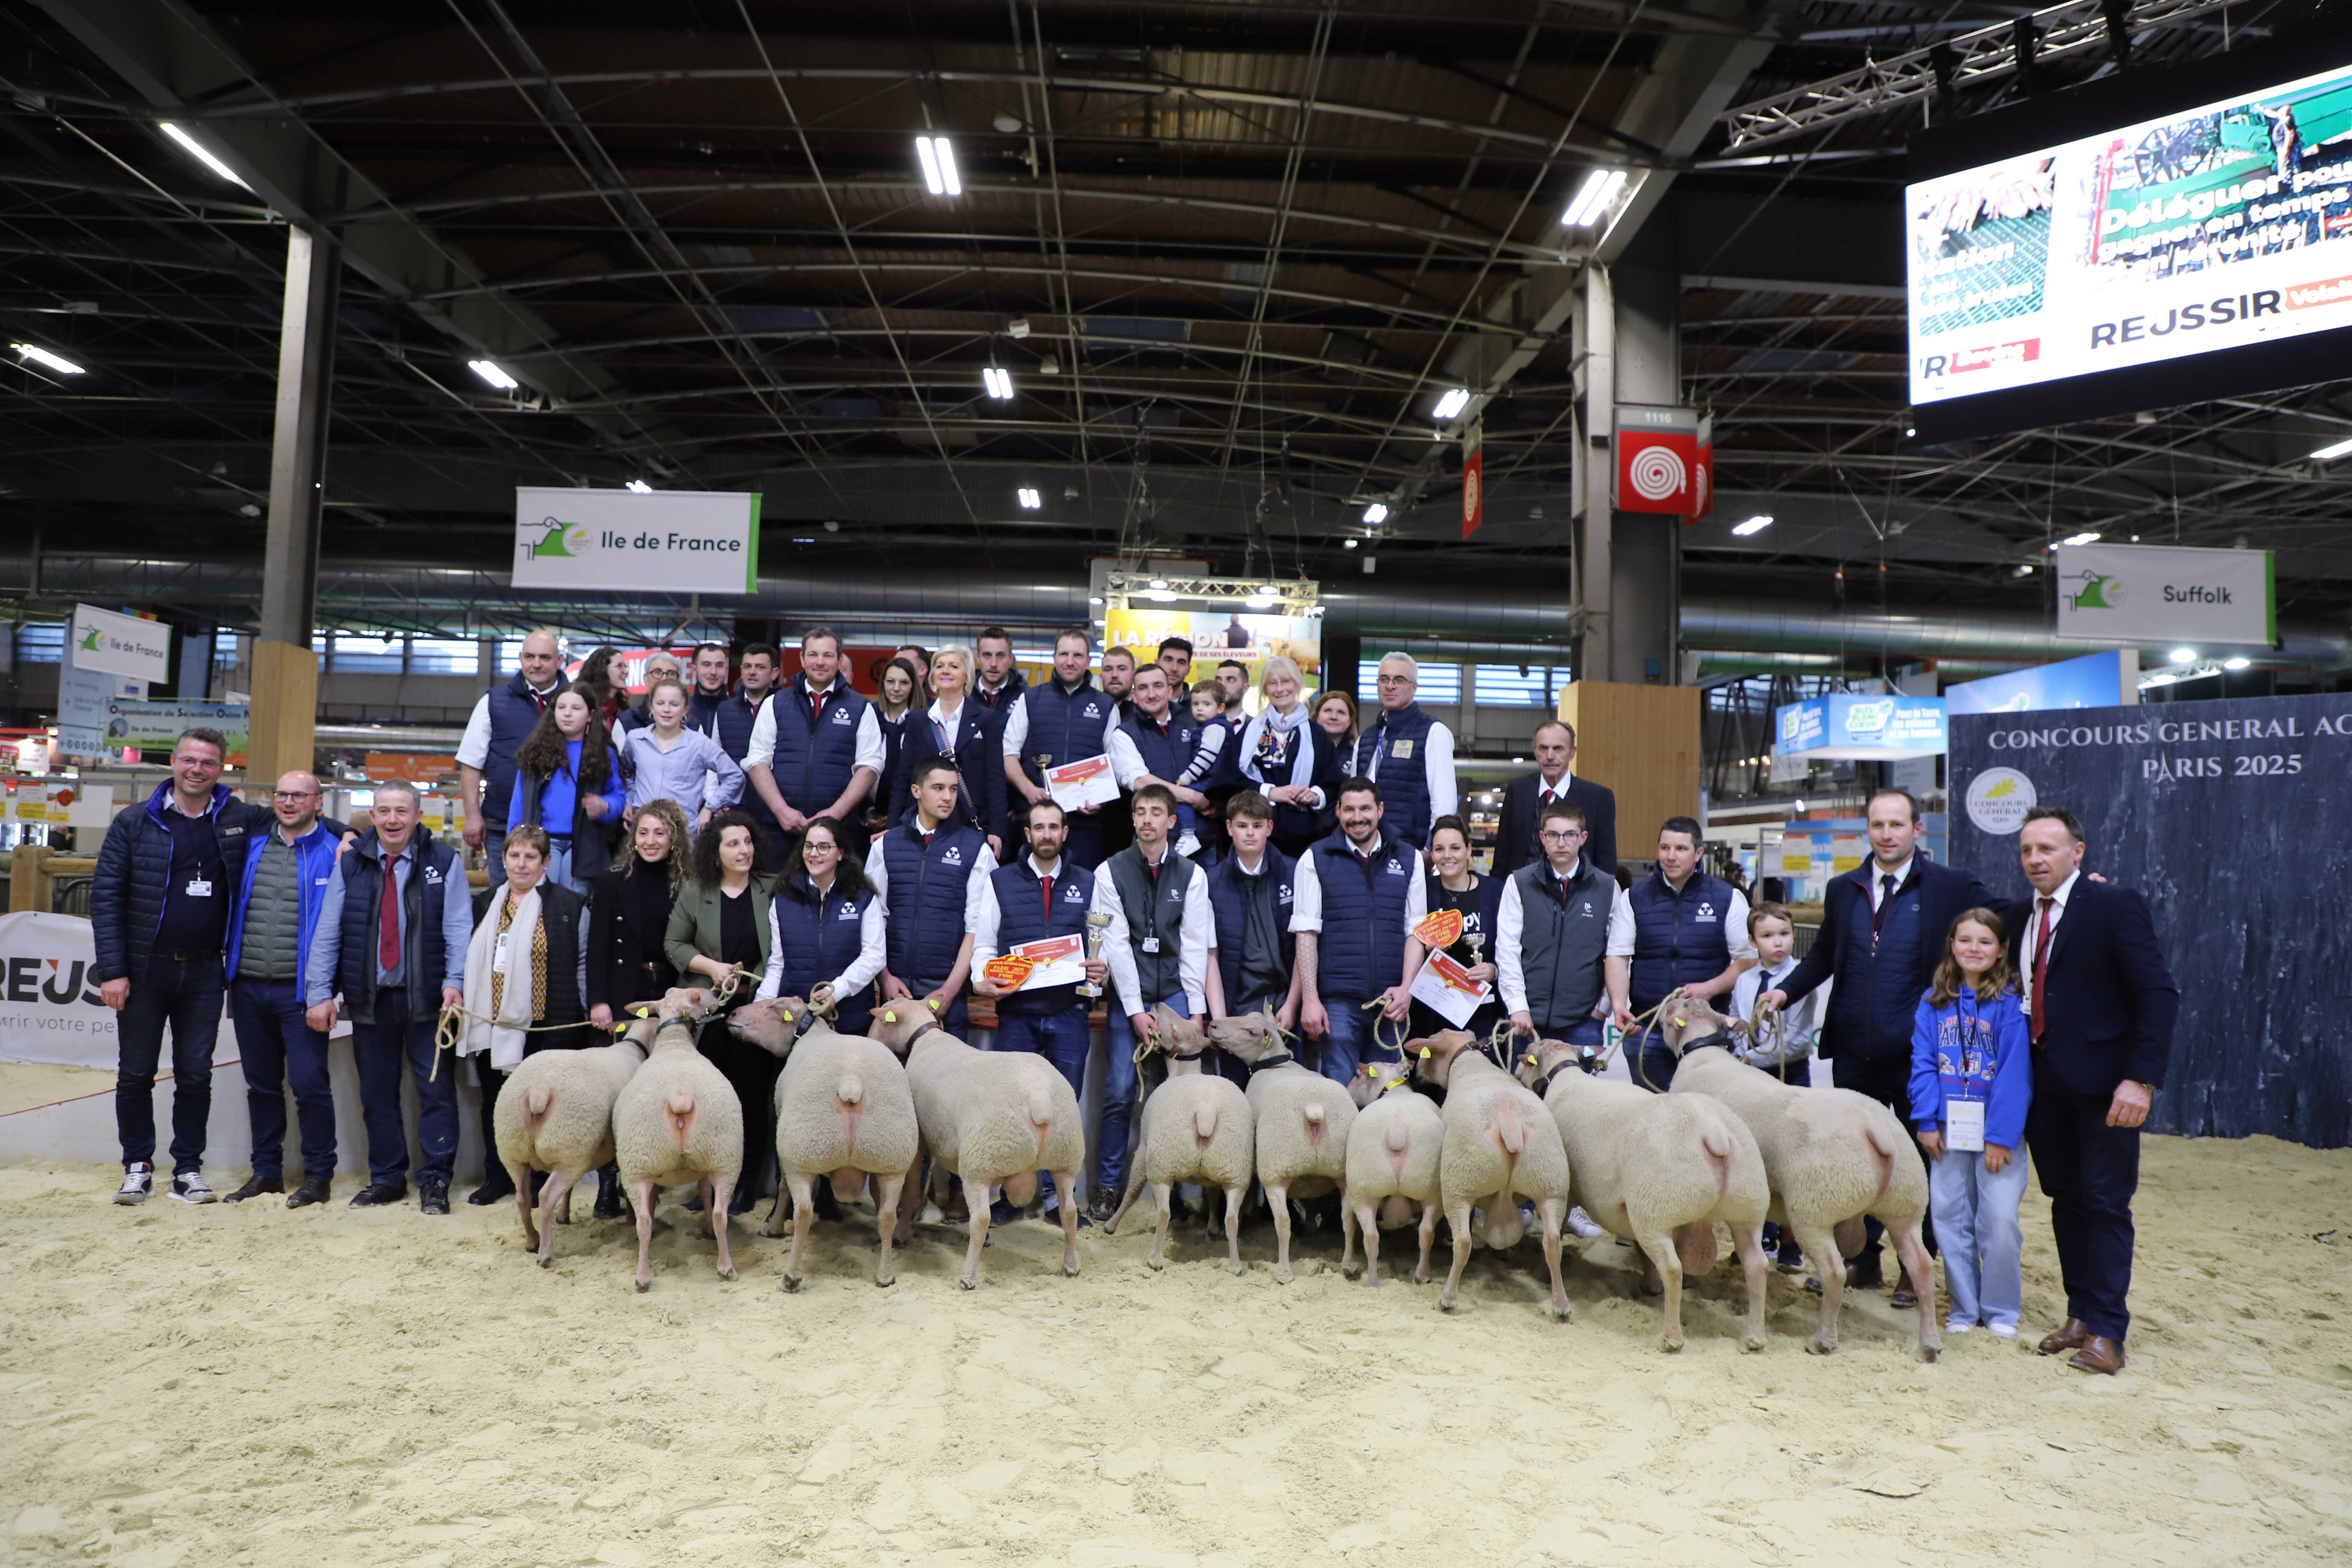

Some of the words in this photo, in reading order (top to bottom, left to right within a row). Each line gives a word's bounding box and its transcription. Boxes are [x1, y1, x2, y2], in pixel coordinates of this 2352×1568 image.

[2102, 173, 2285, 235] Déléguer
[2293, 160, 2352, 192] pou
[2097, 222, 2202, 263] gagner
[2205, 211, 2243, 233] en
[2248, 187, 2350, 222] temps
[1925, 242, 2015, 278] tation
[1965, 282, 2034, 308] truies
[1646, 412, 1672, 424] 1116
[602, 531, 626, 549] Ile
[633, 532, 660, 550] de
[668, 533, 741, 551] France
[2164, 585, 2232, 604] Suffolk
[1113, 630, 1142, 647] LA
[123, 641, 134, 652] de
[136, 643, 164, 658] France
[1893, 719, 1903, 728] les
[1905, 718, 1936, 728] animaux
[1896, 709, 1912, 719] Pour
[1913, 708, 1921, 718] la
[1889, 729, 1897, 738] et
[1899, 729, 1909, 738] les
[1911, 728, 1942, 738] hommes
[1988, 724, 2150, 749] CONCOURS
[2158, 717, 2305, 743] GENERAL
[2143, 750, 2222, 783] PARIS
[2234, 753, 2302, 776] 2025
[1463, 912, 1481, 932] py
[37, 1017, 85, 1031] votre
[92, 1021, 114, 1035] pe
